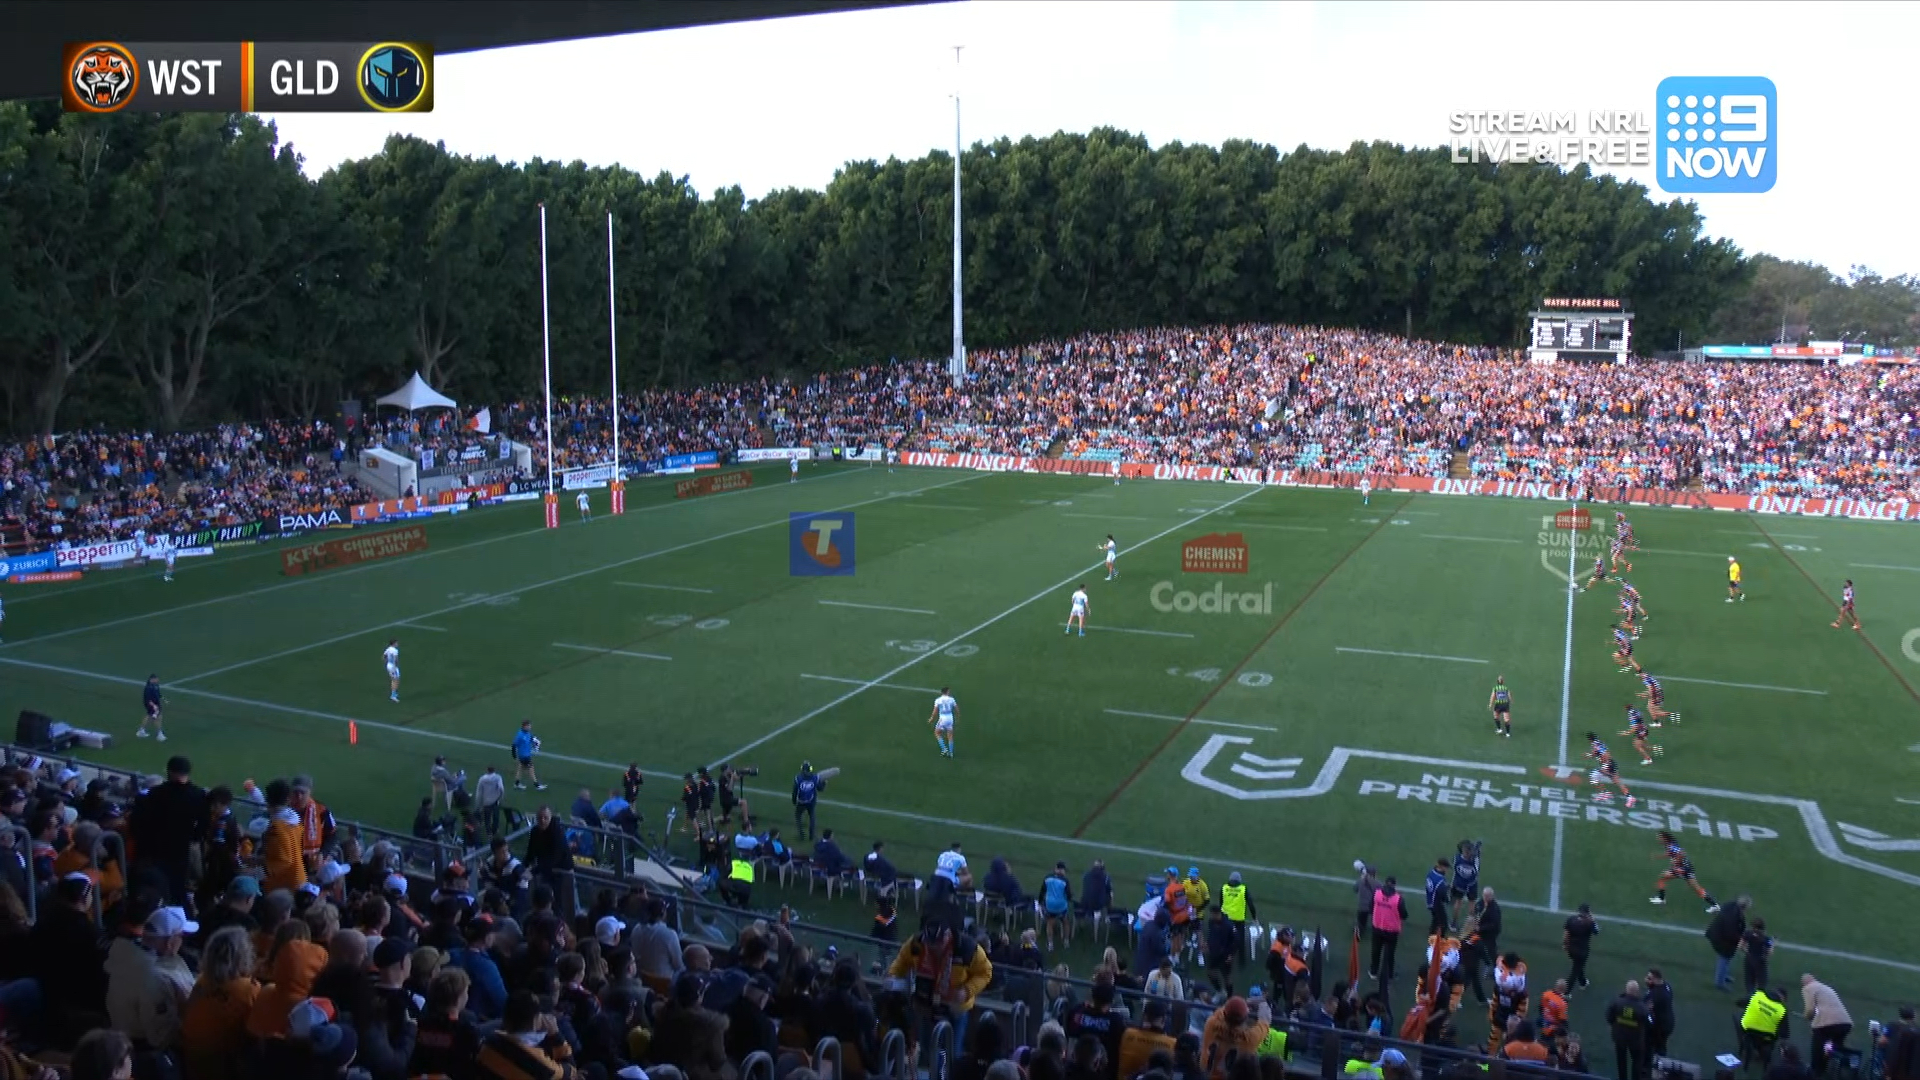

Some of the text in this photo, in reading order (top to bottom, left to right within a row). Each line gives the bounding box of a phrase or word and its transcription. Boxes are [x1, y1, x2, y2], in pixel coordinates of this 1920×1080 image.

[1543, 298, 1570, 308] WAYNE
[1572, 298, 1601, 308] PEARCE
[908, 451, 949, 467] ONE
[952, 453, 1036, 472] JUNGLE
[1153, 464, 1202, 480] ONE
[677, 478, 700, 493] KFC
[1431, 478, 1483, 495] ONE
[1749, 495, 1920, 520] ONE JUNGL
[280, 510, 342, 530] PAMA
[343, 529, 421, 553] CHRISTMAS
[809, 520, 843, 556] T
[1537, 532, 1609, 549] SUNDAY
[286, 543, 327, 567] KFC
[359, 542, 409, 559] IN JULY
[1186, 547, 1244, 561] CHEMIST
[13, 558, 48, 571] ZURICH
[1186, 561, 1242, 569] WAREHOUSE
[1150, 581, 1272, 614] Codral
[899, 640, 979, 657] 30
[1184, 668, 1273, 687] 40
[1422, 773, 1500, 793] NRL
[1358, 780, 1779, 843] PREMIERSHIP
